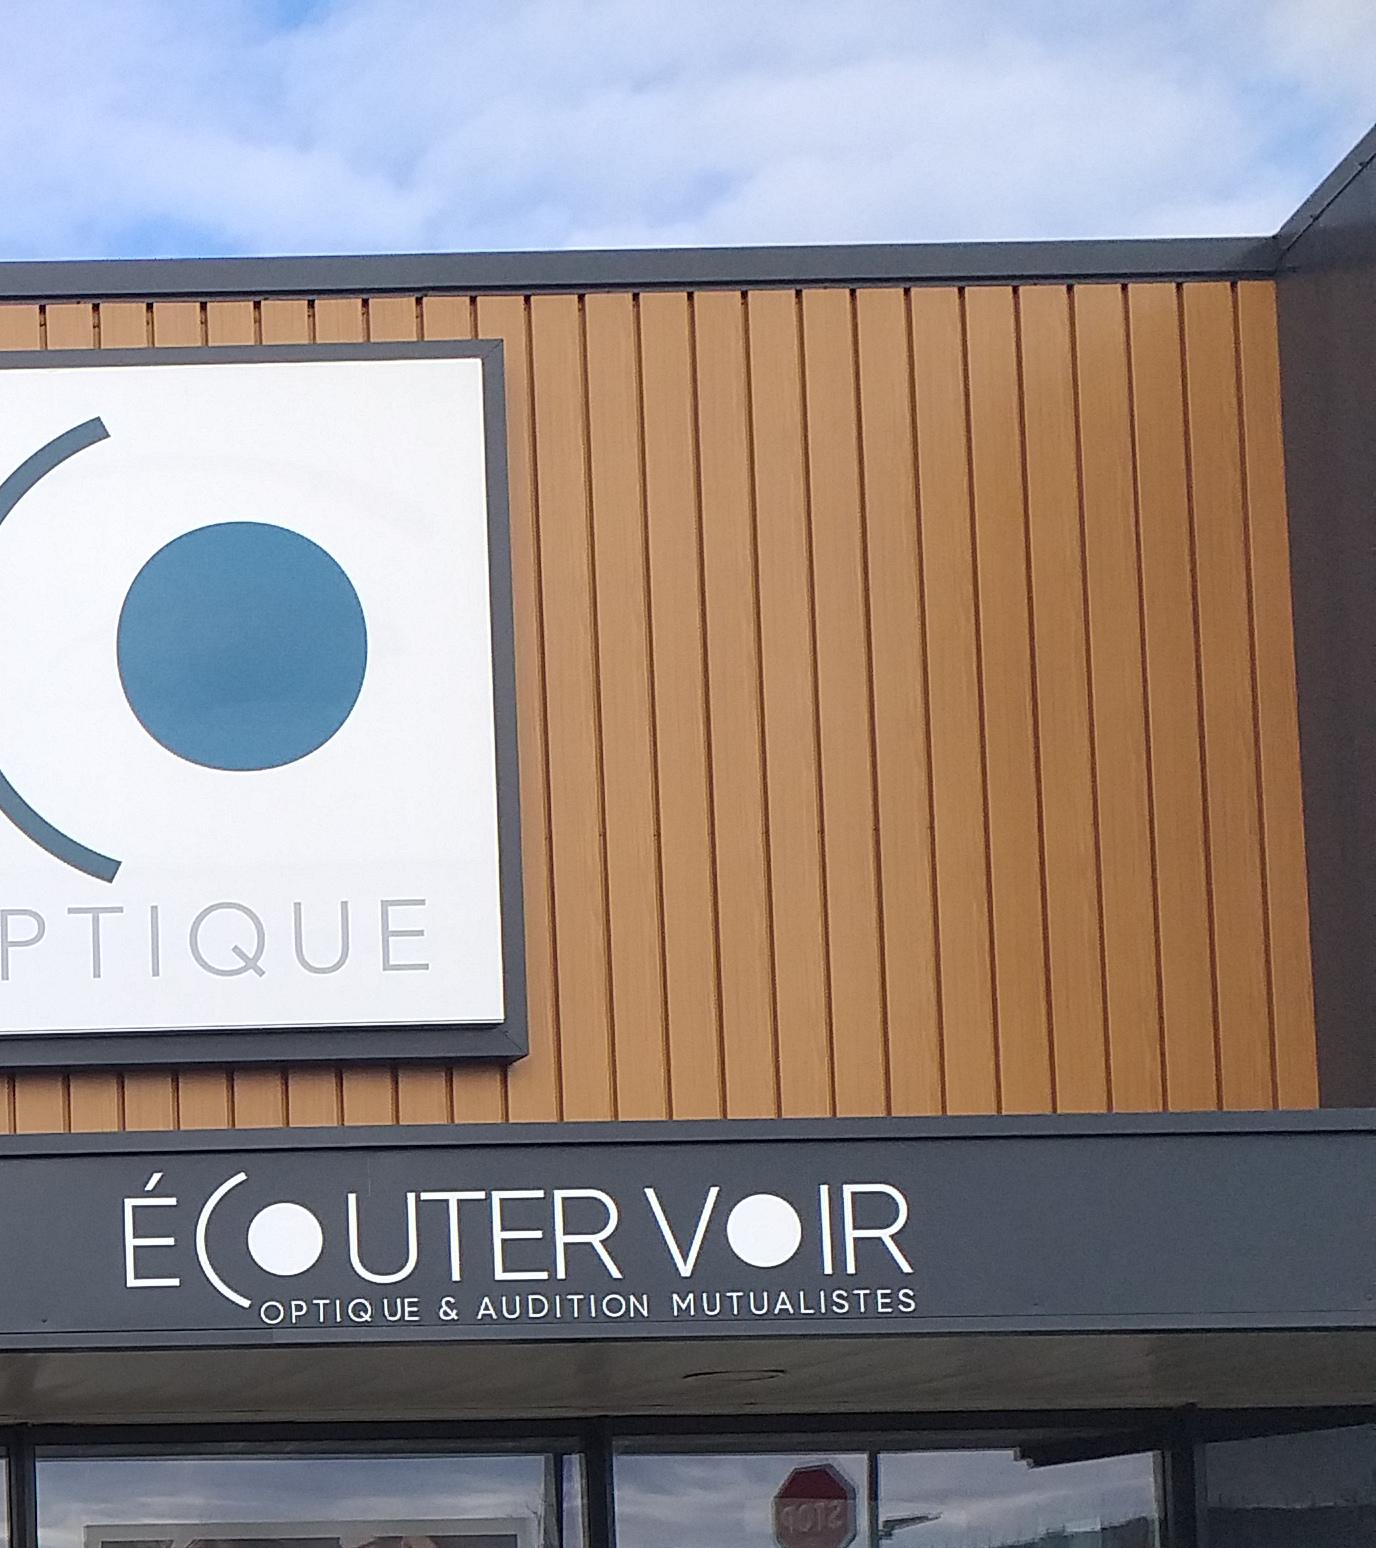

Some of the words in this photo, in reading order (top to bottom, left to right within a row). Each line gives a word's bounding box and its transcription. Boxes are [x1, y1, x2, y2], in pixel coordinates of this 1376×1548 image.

[123, 1171, 621, 1307] ÉCOUTER
[644, 1182, 915, 1278] VOIR
[259, 1295, 420, 1325] OPTIQUE
[438, 1296, 459, 1321] &
[477, 1292, 650, 1320] AUDITION
[672, 1286, 918, 1317] MUTUALISTES
